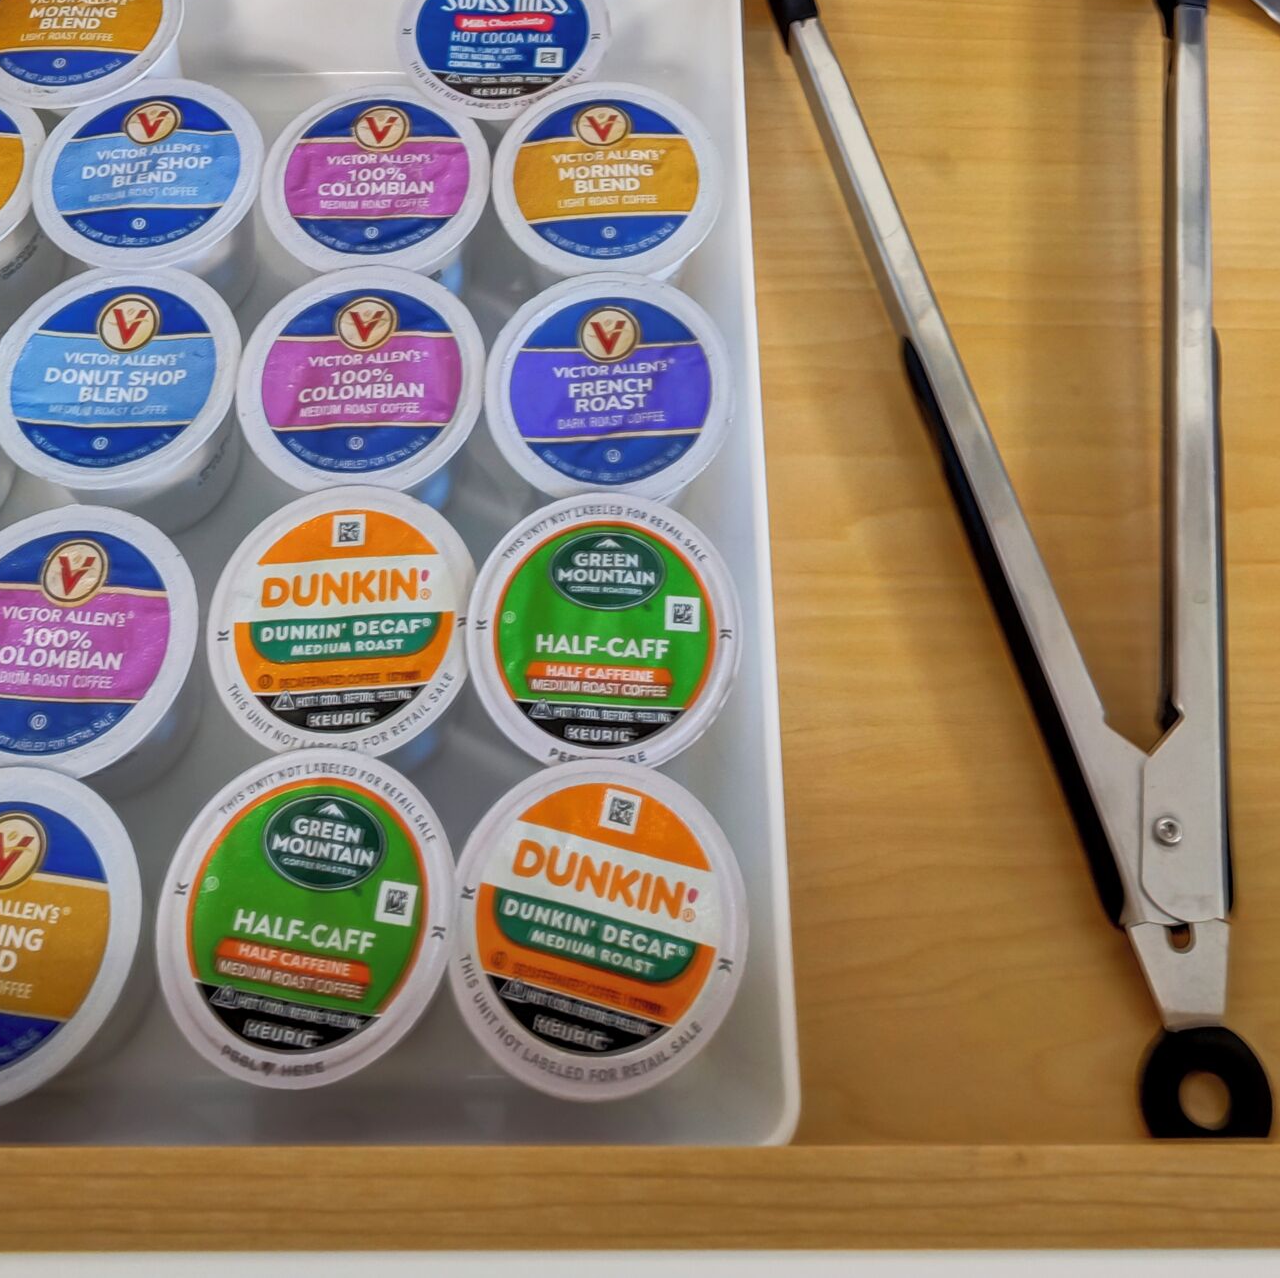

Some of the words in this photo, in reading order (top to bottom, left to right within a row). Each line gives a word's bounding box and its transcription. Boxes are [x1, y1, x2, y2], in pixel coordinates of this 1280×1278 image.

[30, 7, 118, 18] MORNING
[39, 18, 101, 29] BLEND
[451, 32, 478, 43] HOT
[482, 32, 524, 43] COCOA
[528, 33, 553, 43] MIX
[552, 153, 603, 163] VICTOR
[82, 161, 150, 180] DONUT
[158, 156, 212, 169] SHOP
[348, 168, 406, 181] 100%
[559, 164, 654, 180] MORNING
[112, 172, 176, 188] BLEND
[318, 181, 434, 196] COLOMBIAN
[574, 179, 640, 193] BLEND
[44, 368, 123, 384] DONUT
[129, 371, 186, 385] SHOP
[331, 369, 393, 384] 100%
[553, 366, 609, 378] VICTOR
[79, 386, 148, 402] BLEND
[299, 383, 424, 403] COLOMBIAN
[569, 378, 652, 398] FRENCH
[576, 394, 646, 412] ROAST
[575, 552, 639, 568] GREEN
[558, 569, 656, 584] MOUNTAIN
[260, 568, 430, 608] DUNKIN'
[2, 605, 63, 623] VICTOR
[21, 627, 92, 649] 100%
[261, 622, 347, 641] DUNKIN'
[353, 619, 420, 637] DECAF
[291, 641, 351, 656] MEDIUM
[356, 639, 403, 652] ROAST
[536, 634, 670, 659] HALF-CAFF
[546, 664, 580, 679] HALF
[583, 665, 654, 681] CAFFEINE
[532, 679, 578, 692] MEDIUM
[581, 681, 620, 694] ROAST
[623, 683, 667, 697] COFFEE
[294, 817, 359, 842] GREEN
[271, 833, 374, 867] MOUNTAIN
[511, 839, 698, 920] DUNKIN'
[234, 908, 376, 954] HALF-CAFF
[503, 898, 596, 934] DUNKIN'
[602, 925, 677, 960] DECAF
[238, 943, 273, 960] HALF
[276, 950, 351, 976] CAFFEINE
[531, 929, 593, 956] MEDIUM
[599, 946, 654, 972] ROAST
[219, 958, 272, 983] MEDIUM
[276, 966, 313, 989] ROAST
[317, 972, 365, 999] COFFEE
